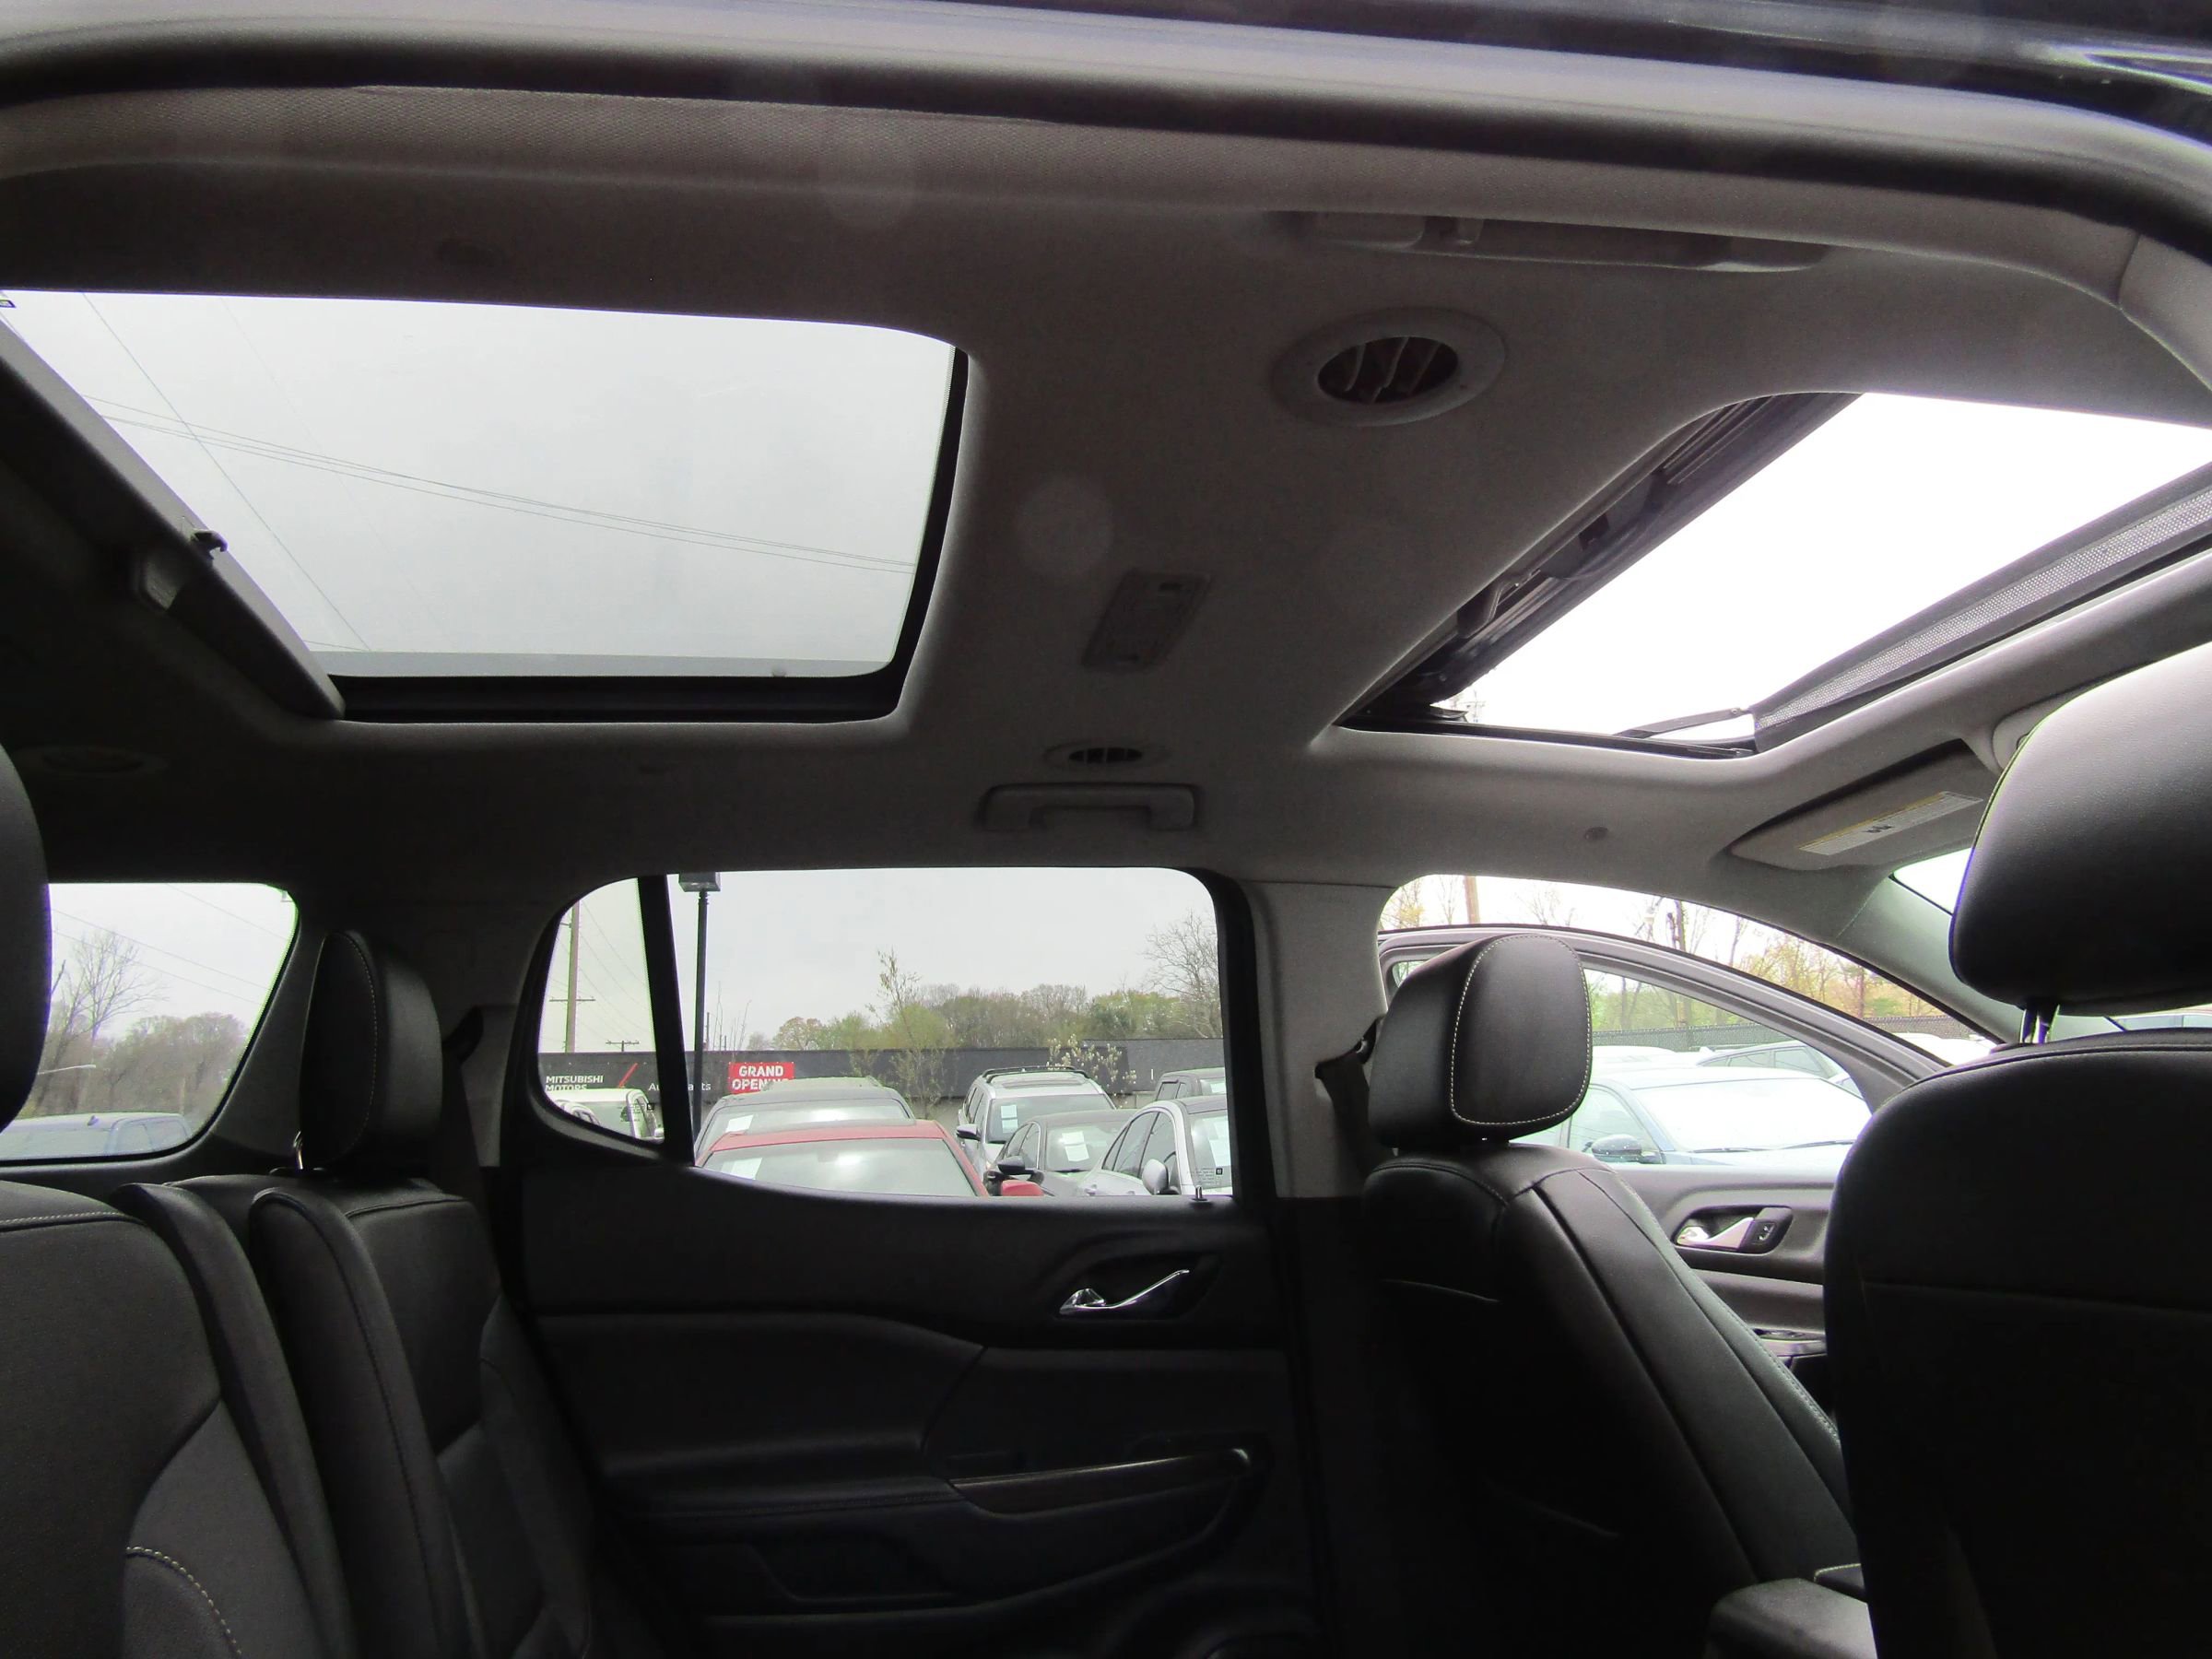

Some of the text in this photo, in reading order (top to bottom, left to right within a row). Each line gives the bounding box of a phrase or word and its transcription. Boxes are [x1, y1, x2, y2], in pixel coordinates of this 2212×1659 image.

[738, 1065, 784, 1077] GRAND
[546, 1075, 604, 1084] MITSUBISHI
[732, 1078, 789, 1090] OPEN
